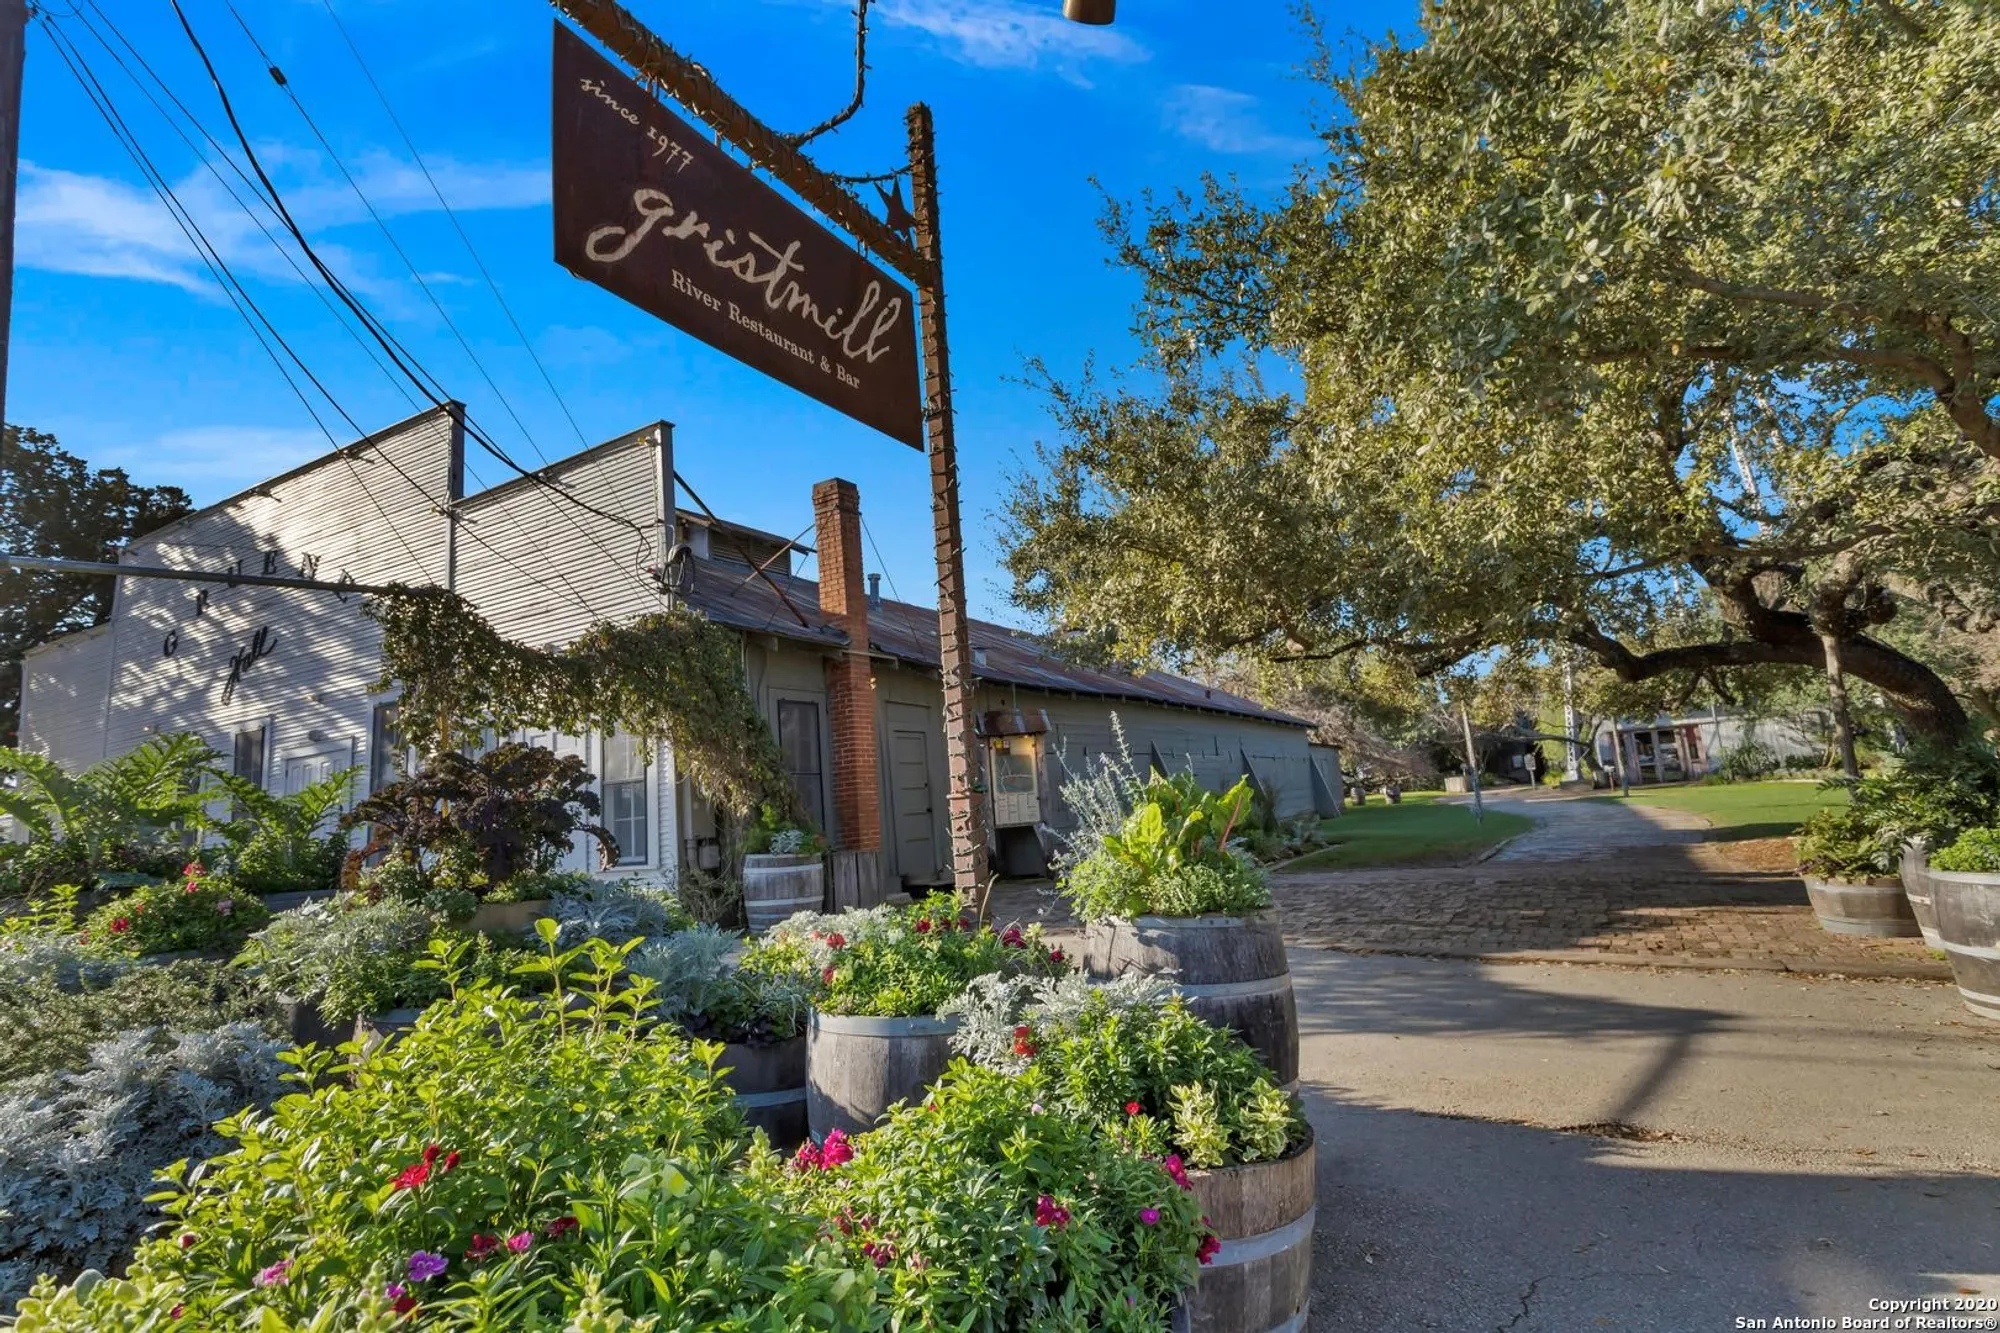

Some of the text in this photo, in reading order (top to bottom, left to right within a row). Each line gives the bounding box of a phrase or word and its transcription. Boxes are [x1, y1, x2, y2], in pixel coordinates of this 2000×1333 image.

[580, 79, 694, 173] since 1977
[585, 188, 901, 363] gristmill
[671, 269, 861, 390] River Restaurant & Bar
